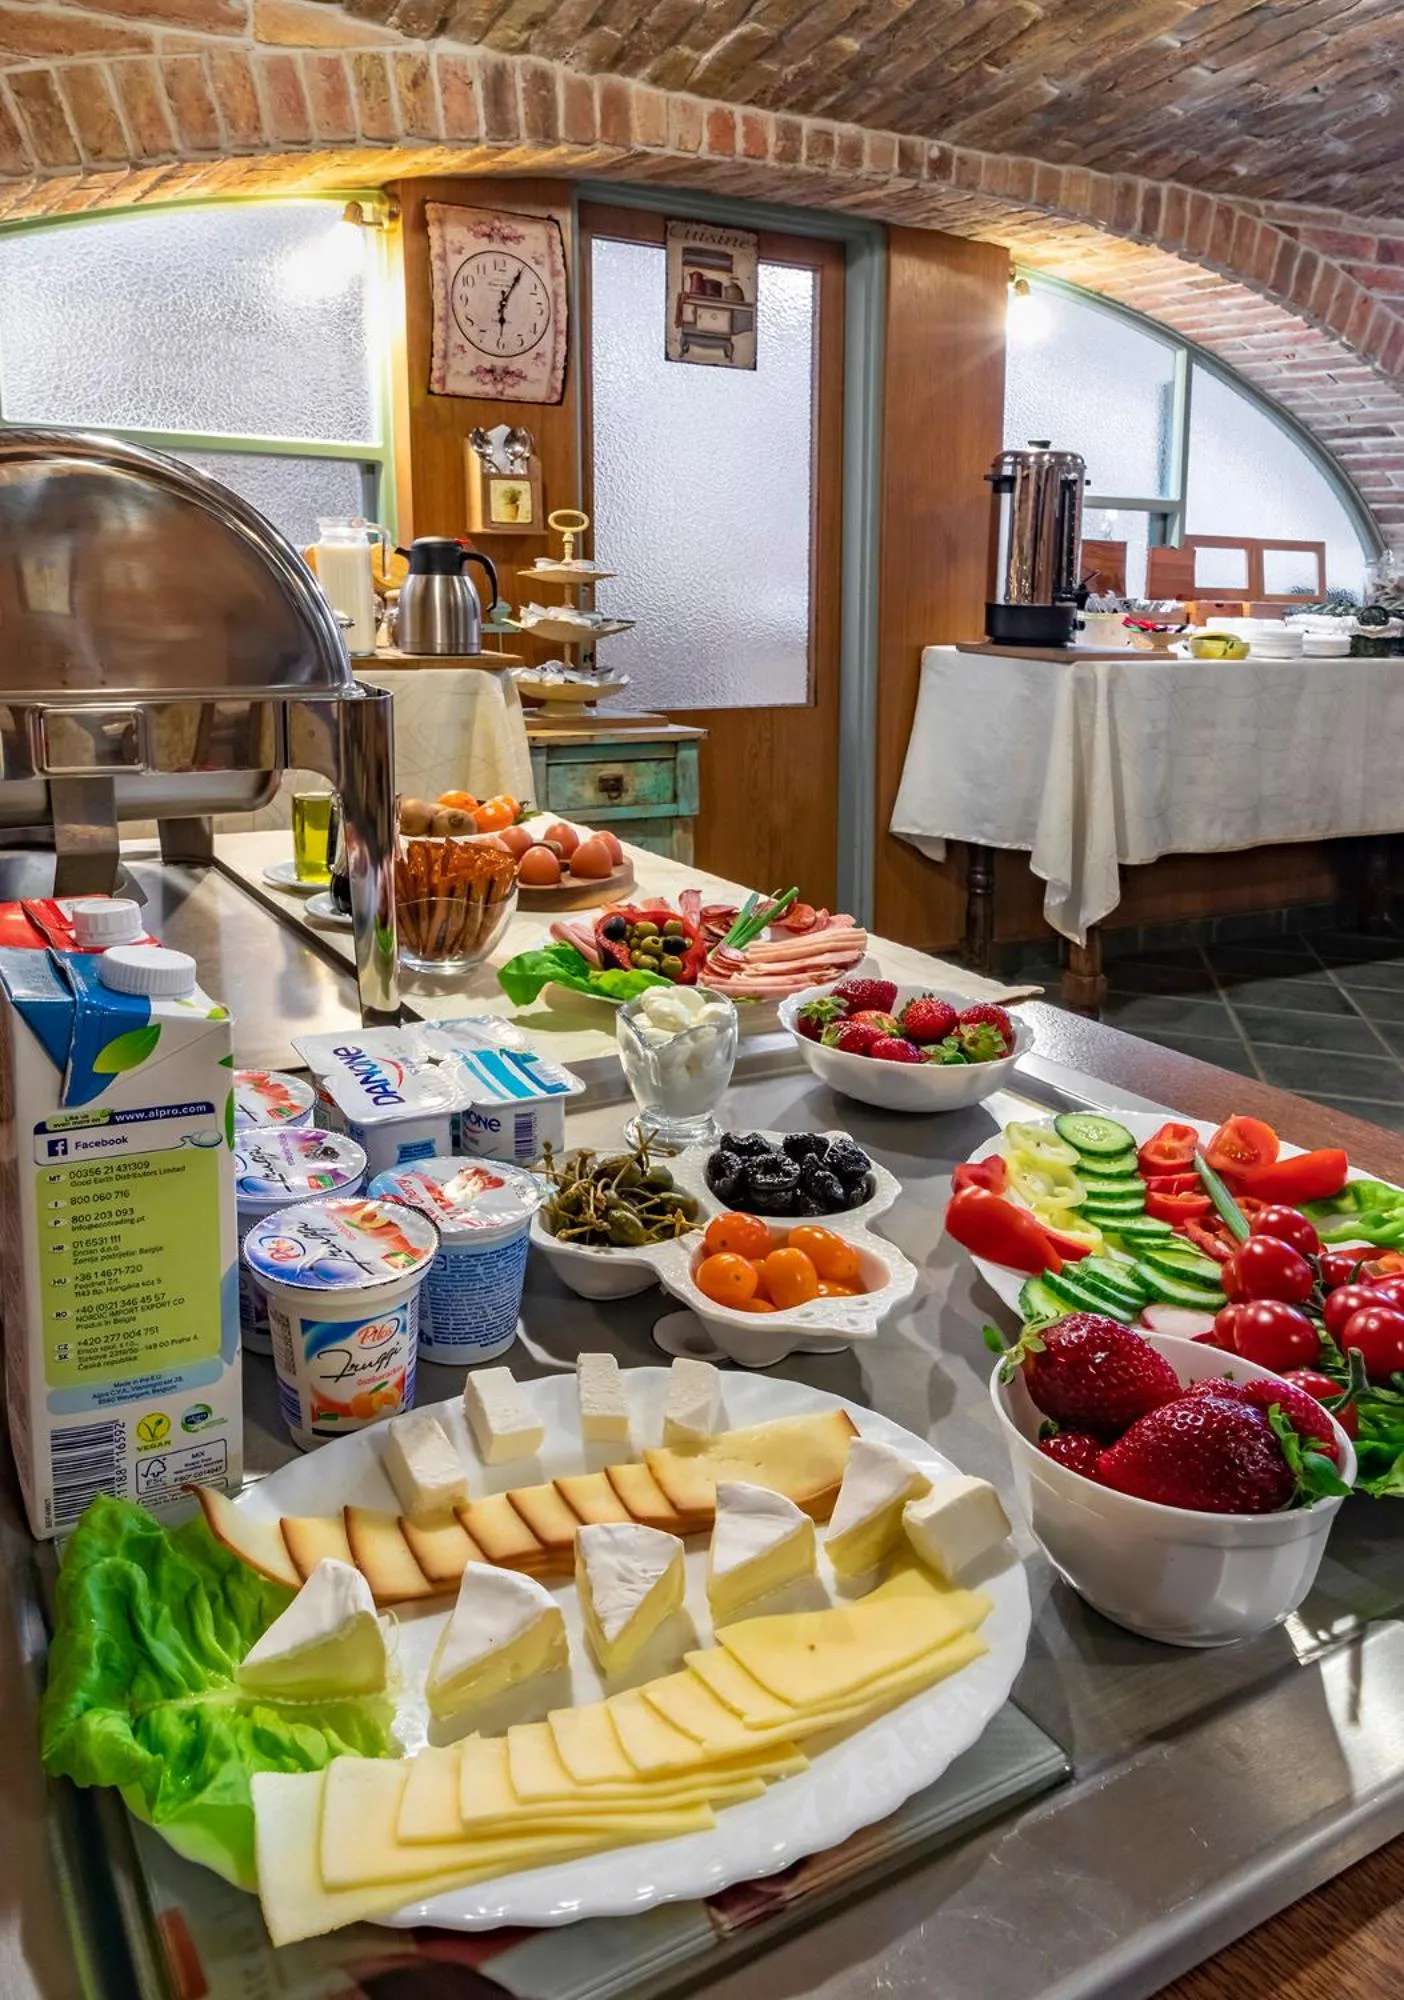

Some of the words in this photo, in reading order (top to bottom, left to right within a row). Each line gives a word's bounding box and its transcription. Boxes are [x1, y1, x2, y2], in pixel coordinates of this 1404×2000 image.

[462, 275, 476, 288] 10
[115, 1104, 207, 1122] www.alpro.com
[75, 1136, 128, 1151] Facebook
[69, 1167, 101, 1180] 00356
[103, 1165, 114, 1175] 21
[115, 1161, 150, 1173] 431309
[70, 1179, 92, 1188] Good
[70, 1195, 90, 1206] 800
[92, 1191, 112, 1202] 060
[71, 1214, 92, 1225] 800
[93, 1210, 113, 1221] 203
[115, 1207, 134, 1217] 093
[77, 1336, 101, 1347] +420
[103, 1332, 121, 1344] 277
[122, 1328, 142, 1340] 004
[136, 1439, 172, 1452] VEGAN
